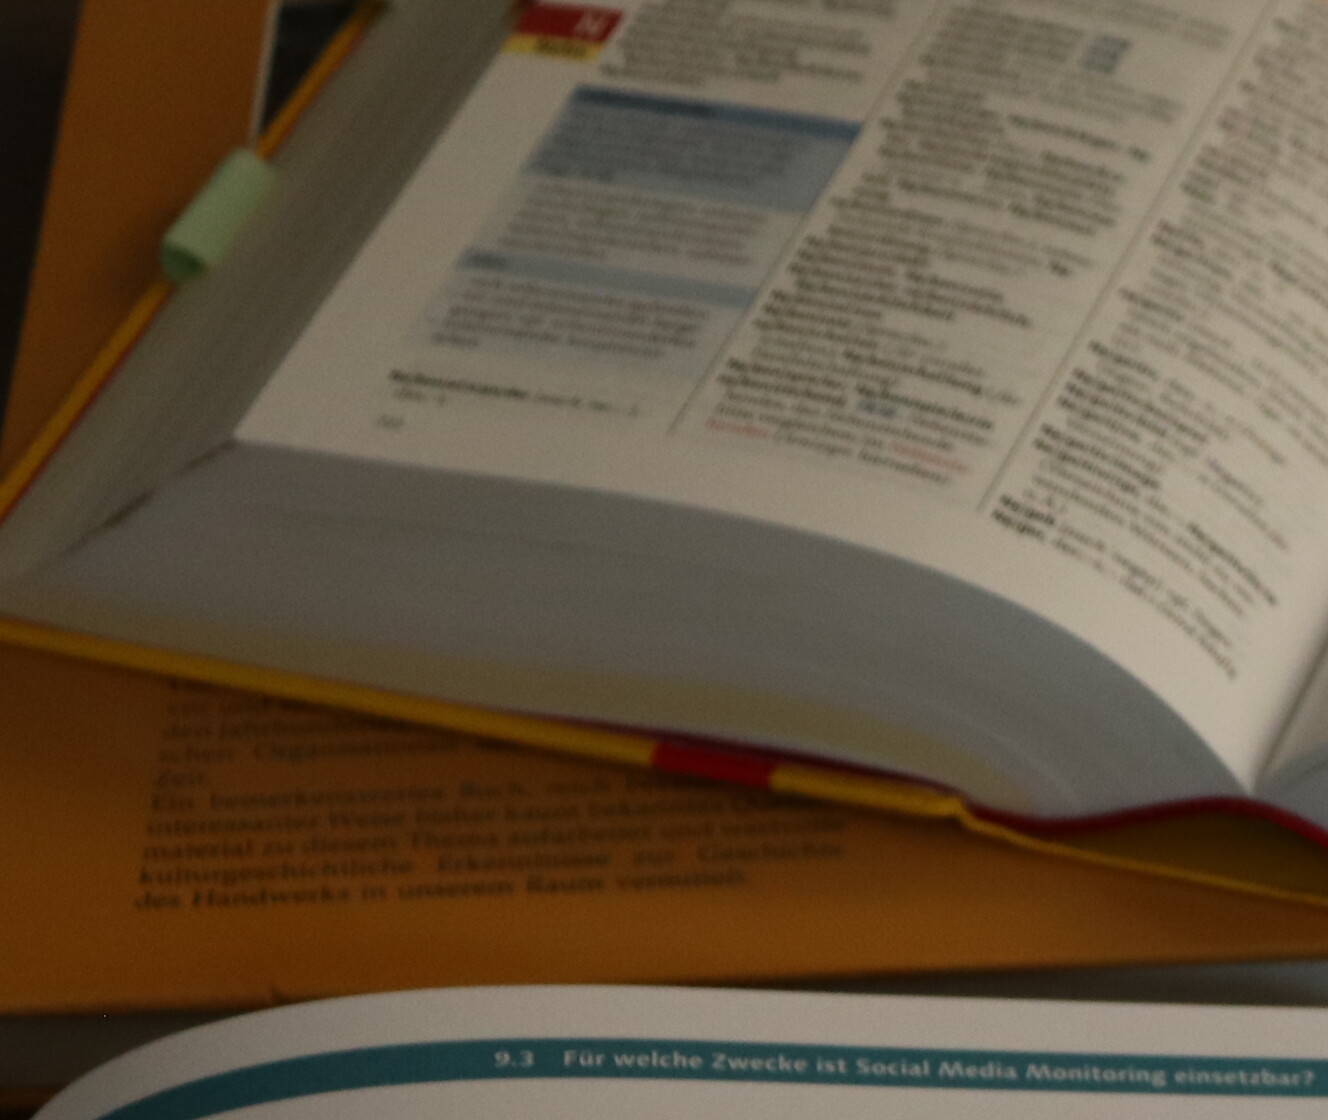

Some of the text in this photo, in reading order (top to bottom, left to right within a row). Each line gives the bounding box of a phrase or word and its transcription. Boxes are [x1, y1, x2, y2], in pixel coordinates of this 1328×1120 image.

[493, 1049, 1315, 1088] 9.3 Für welche Zwecke ist Social Media Monitoring einsetzbar?
